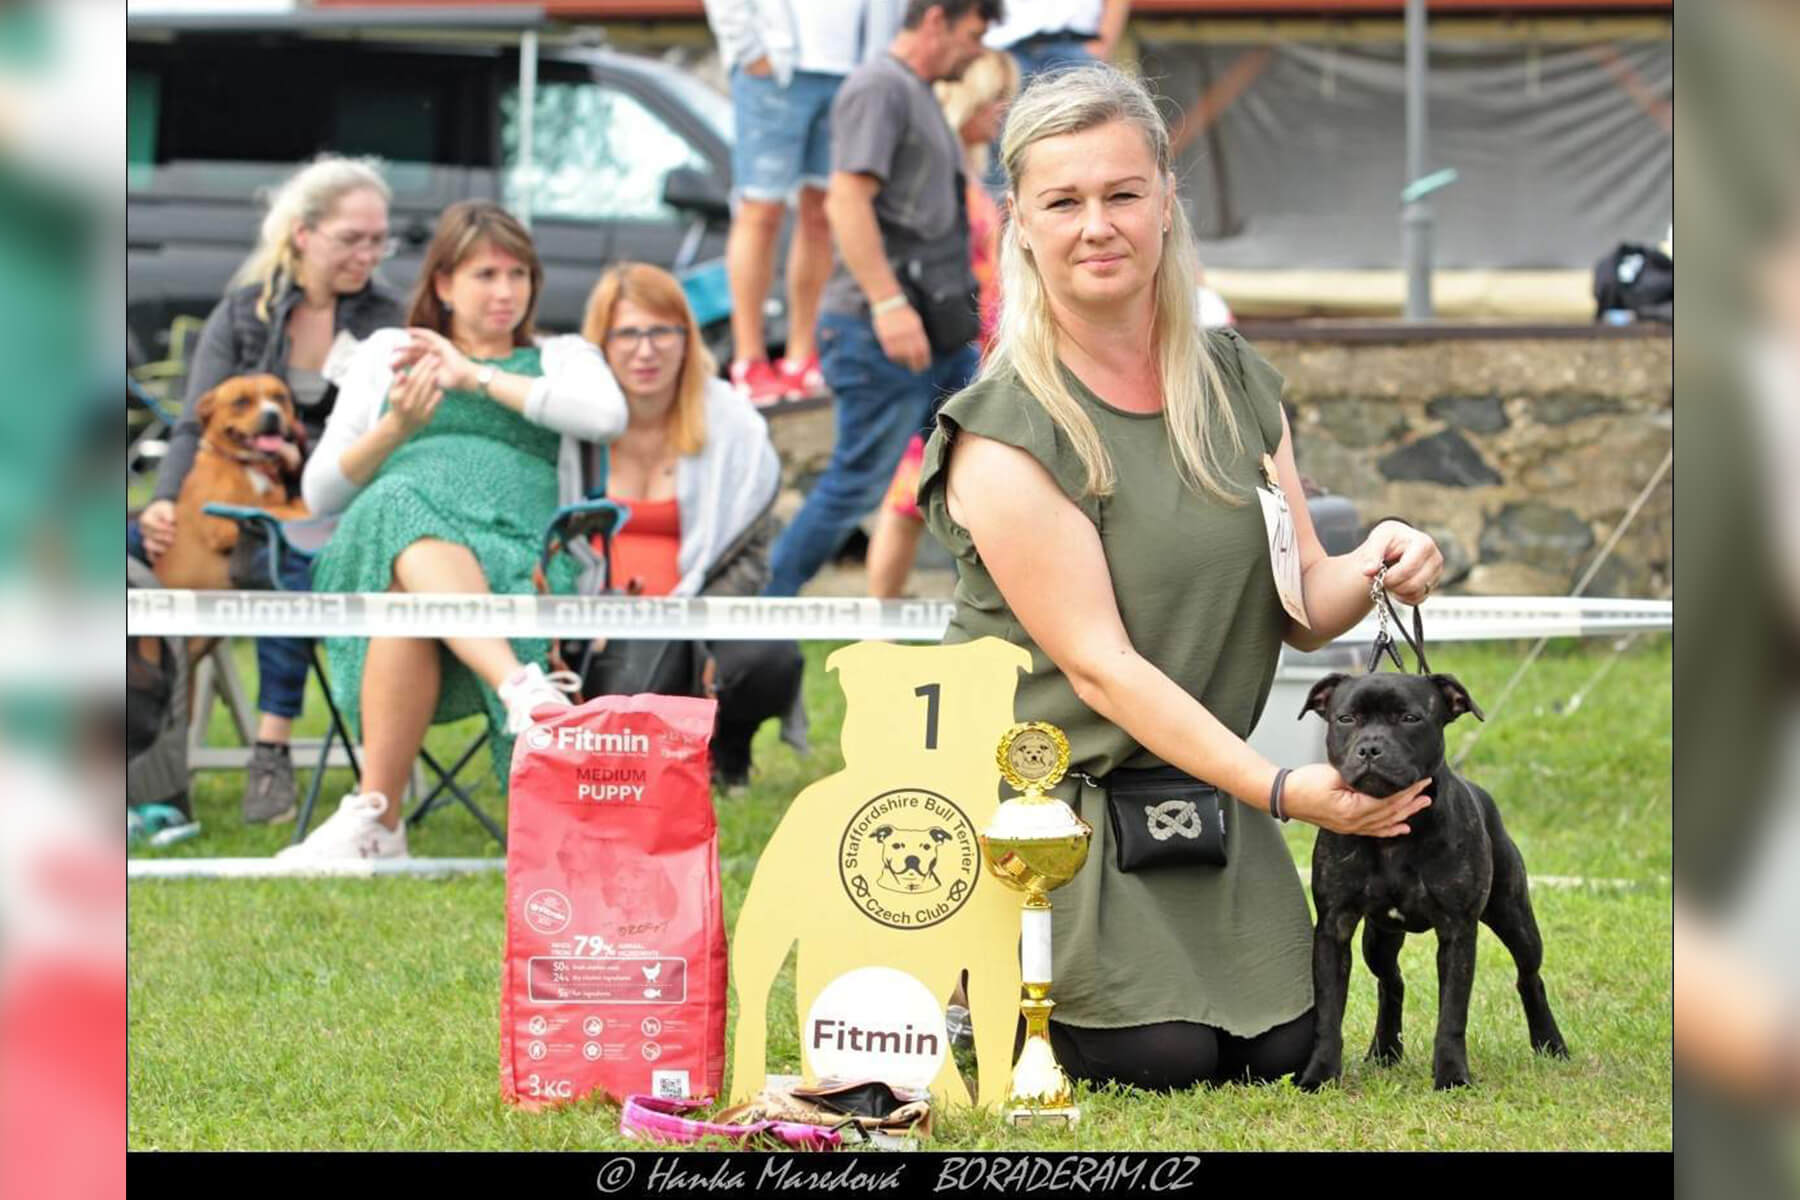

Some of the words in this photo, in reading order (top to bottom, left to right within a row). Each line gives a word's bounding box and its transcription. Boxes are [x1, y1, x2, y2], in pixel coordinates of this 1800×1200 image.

[914, 682, 941, 750] 1
[557, 726, 649, 753] Fitmin
[576, 768, 647, 783] MEDIUM
[578, 784, 646, 801] PUPPY
[845, 795, 920, 869] Staffordshire
[924, 796, 956, 823] Bull
[952, 816, 976, 874] Terrier
[865, 897, 911, 925] Czech
[915, 902, 950, 924] Club
[813, 1019, 939, 1055] Fitmin
